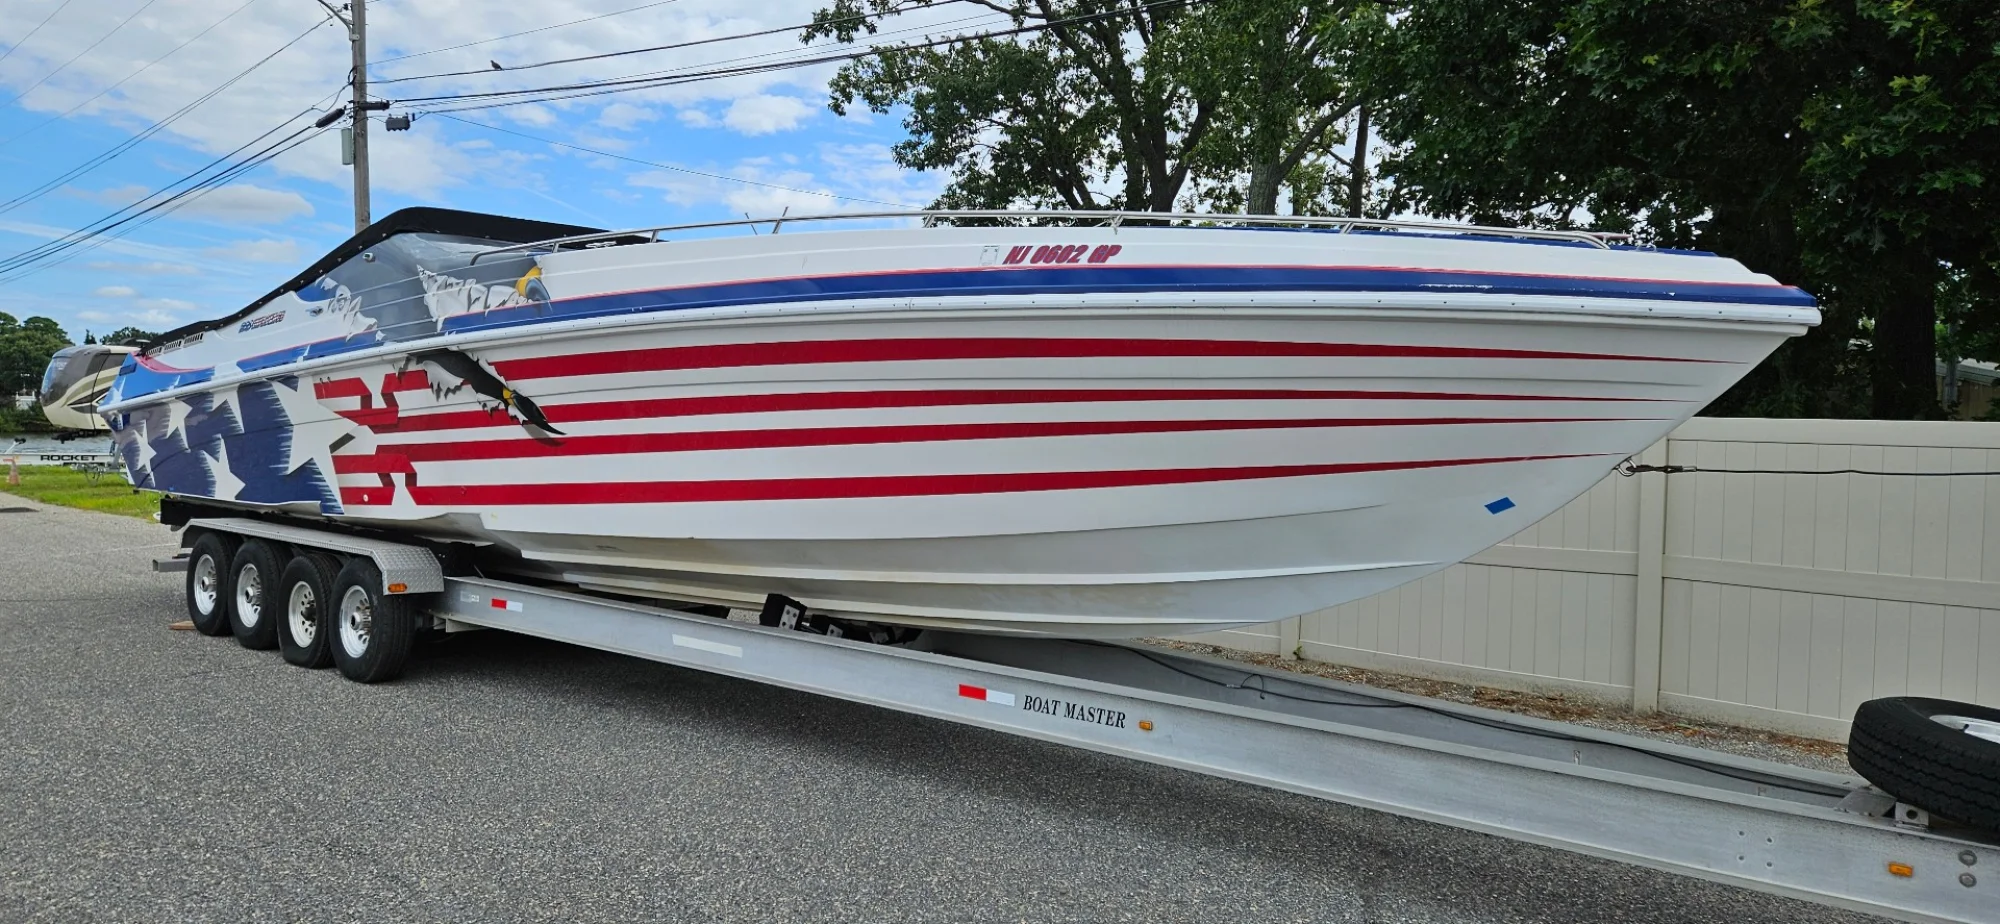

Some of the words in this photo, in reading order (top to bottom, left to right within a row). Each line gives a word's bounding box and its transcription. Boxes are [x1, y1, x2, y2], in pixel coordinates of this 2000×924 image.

[1002, 245, 1033, 264] NJ
[1030, 244, 1089, 264] 0602
[1023, 695, 1061, 717] BOAT
[1063, 701, 1126, 729] MASTER
